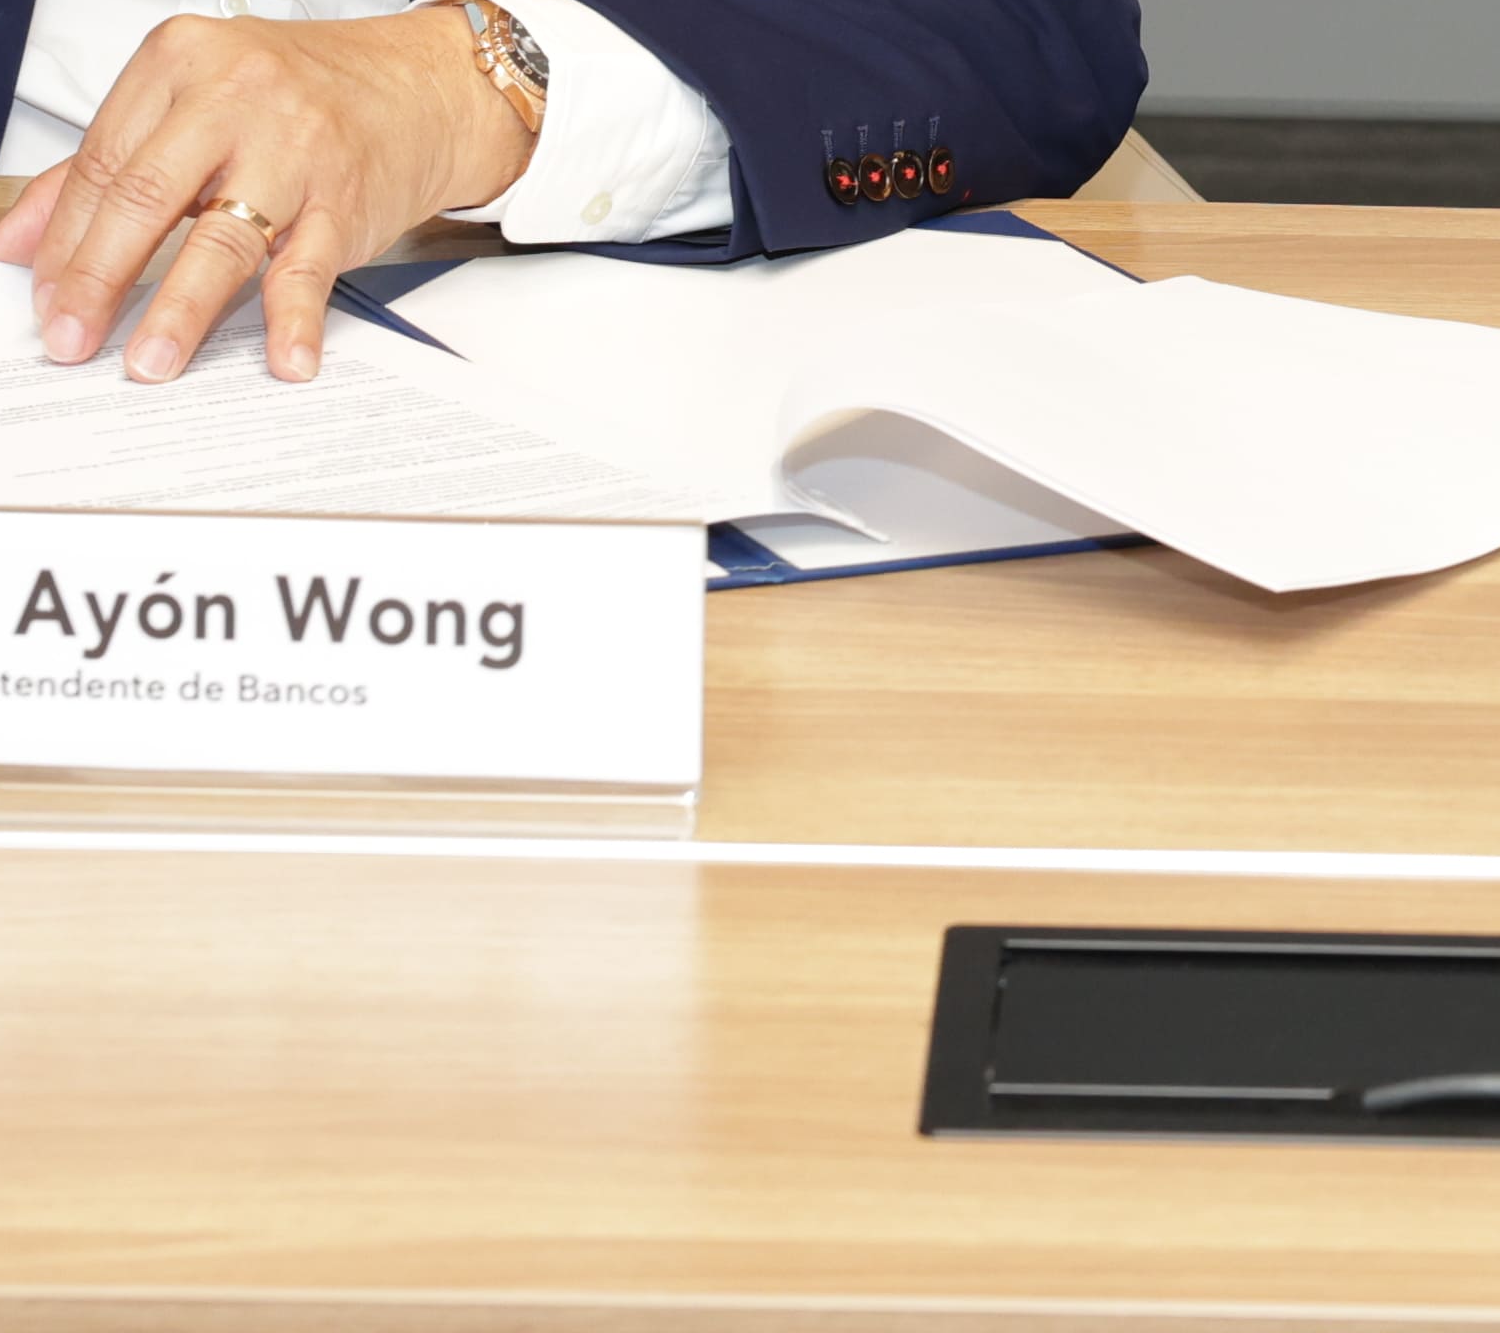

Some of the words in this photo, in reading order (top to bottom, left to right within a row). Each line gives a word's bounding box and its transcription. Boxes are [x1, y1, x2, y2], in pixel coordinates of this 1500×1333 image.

[13, 568, 238, 662] Ayón
[275, 574, 526, 672] Wong
[177, 677, 225, 701] de
[238, 675, 369, 706] Bancos
